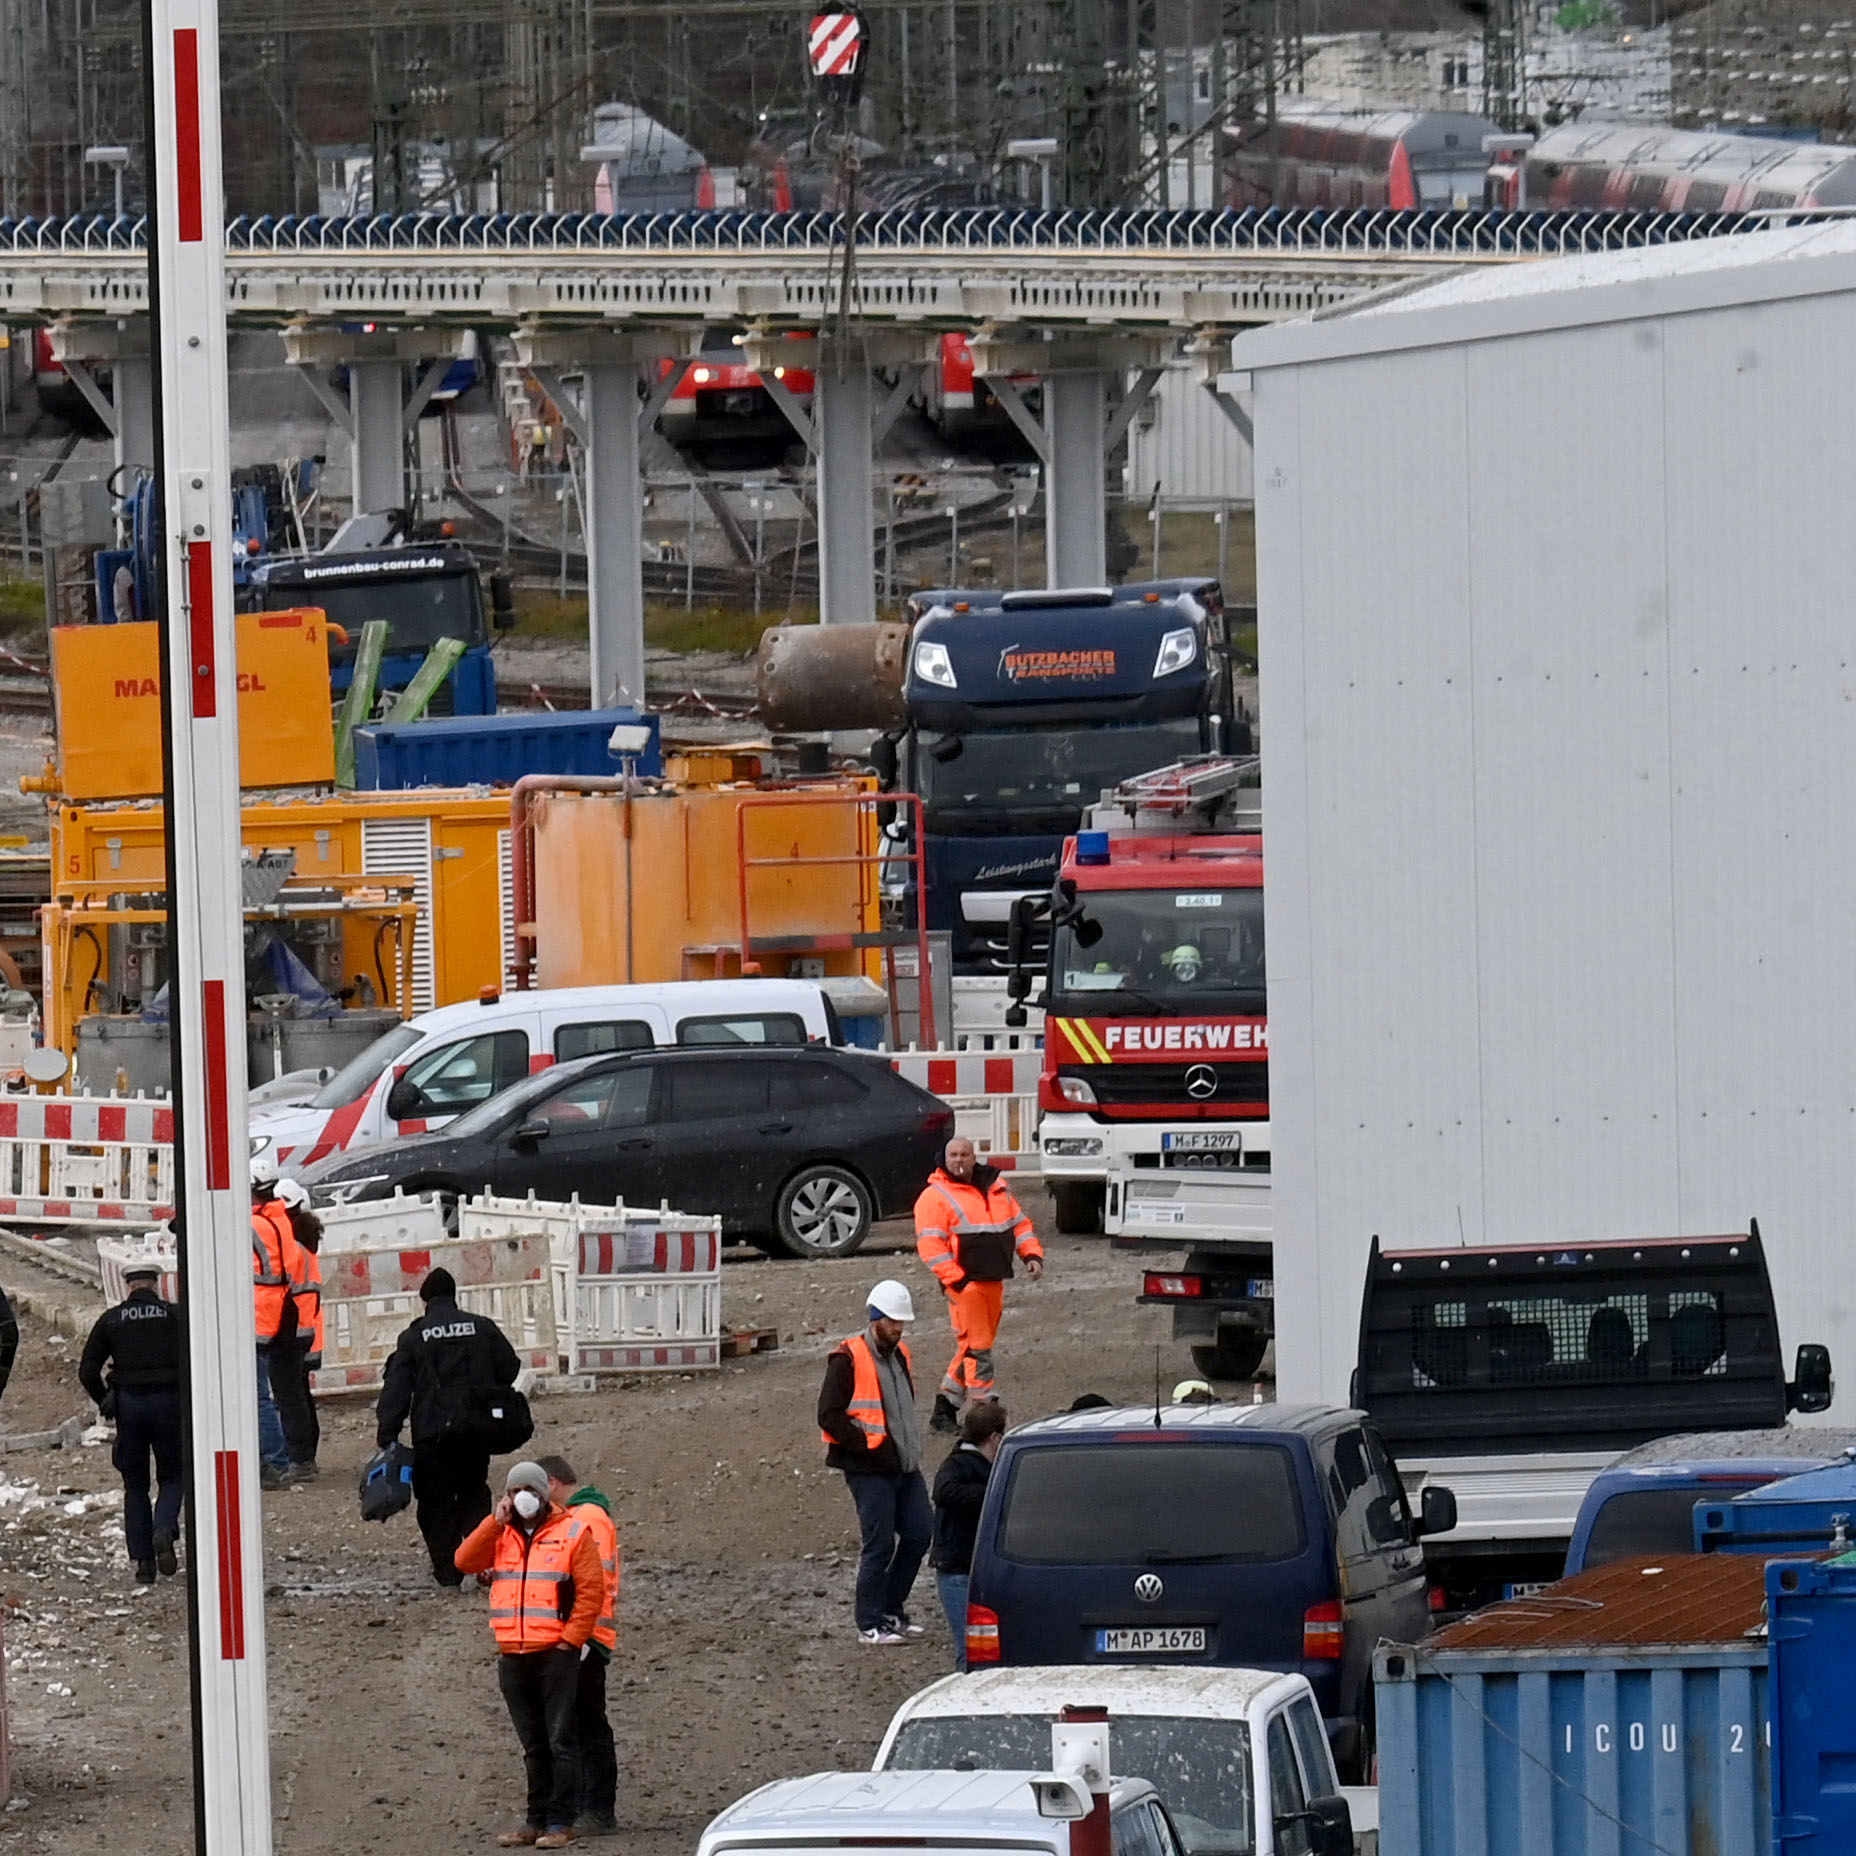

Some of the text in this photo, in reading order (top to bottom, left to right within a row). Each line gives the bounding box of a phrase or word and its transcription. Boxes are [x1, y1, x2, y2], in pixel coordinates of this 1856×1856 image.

[304, 558, 445, 578] brunnenbau-conrad.de
[114, 674, 267, 698] MA GL
[1105, 1025, 1269, 1051] FEUERWEH
[1202, 1132, 1234, 1148] 1297
[120, 1304, 168, 1321] POLIZEI
[422, 1321, 477, 1342] POLIZEI
[1106, 1629, 1204, 1650] M AP 1678
[1564, 1723, 1686, 1753] ICOU
